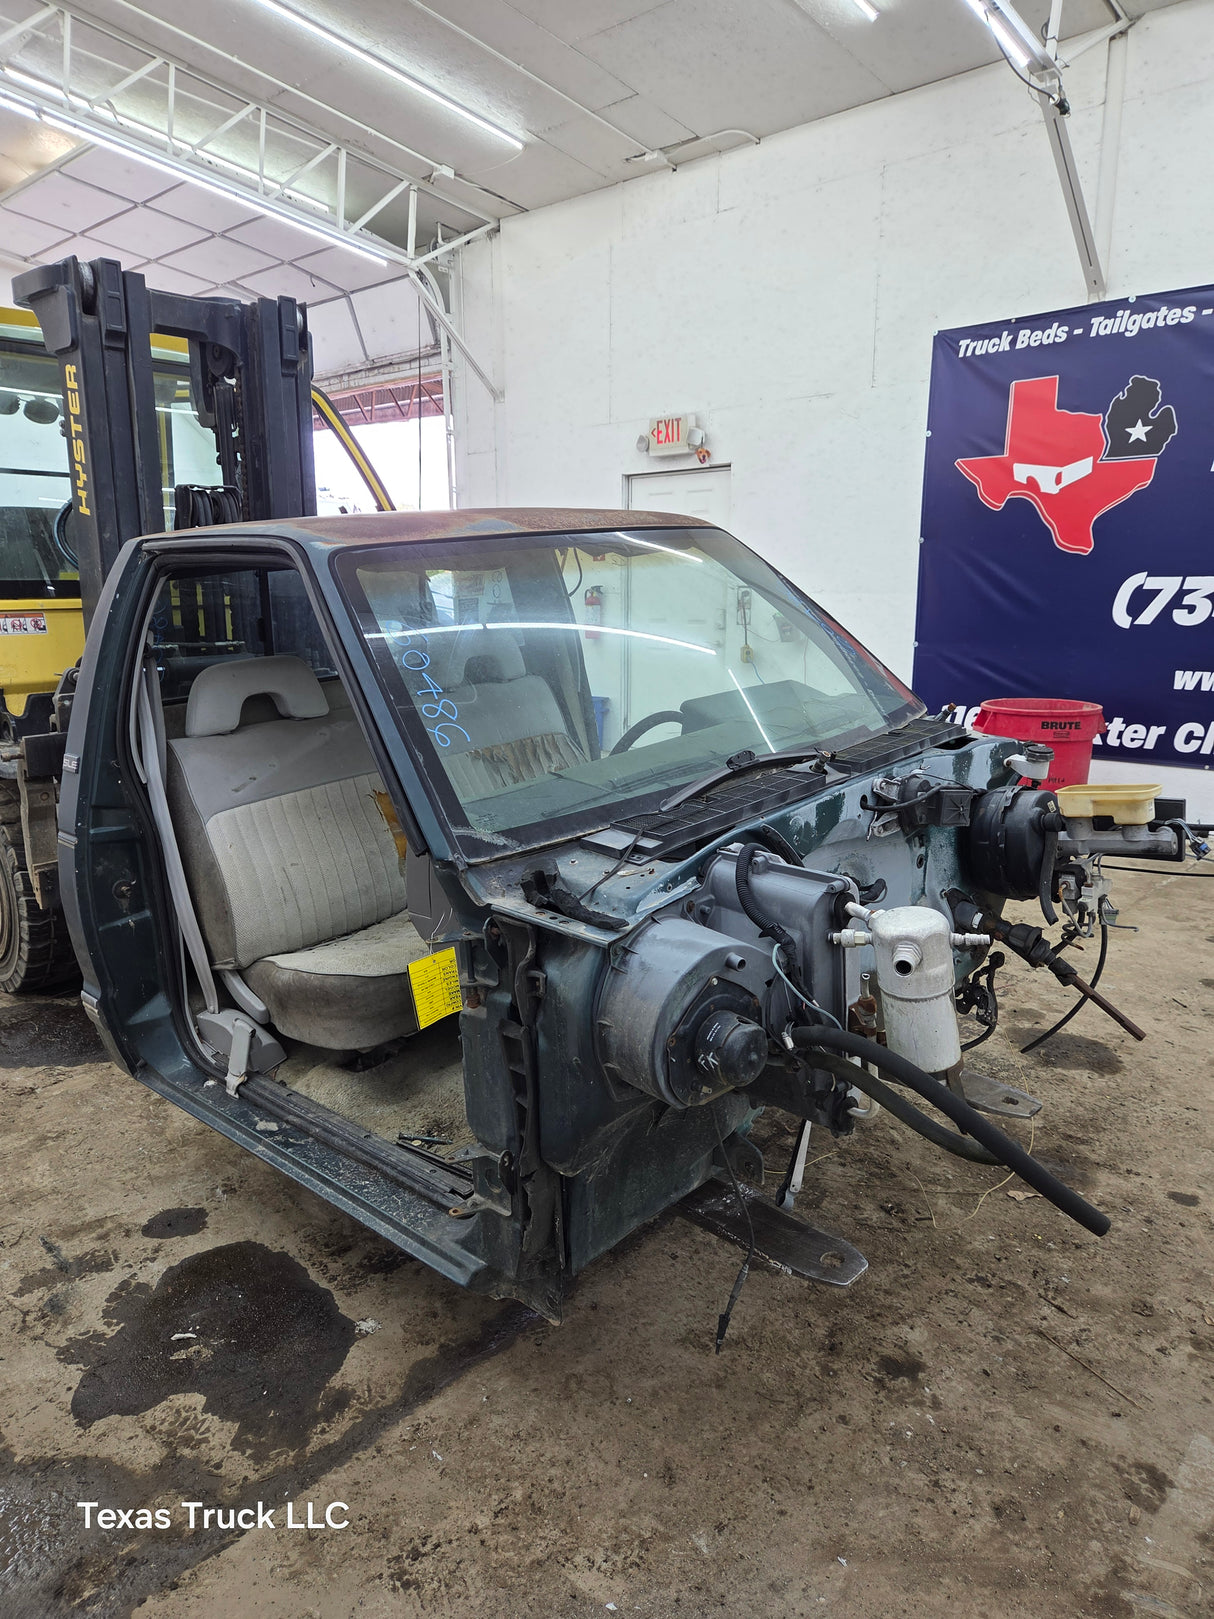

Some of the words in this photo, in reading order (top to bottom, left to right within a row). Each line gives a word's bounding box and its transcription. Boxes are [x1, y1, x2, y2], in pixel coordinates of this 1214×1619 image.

[958, 331, 1012, 358] Truck
[1015, 322, 1068, 349] Beds
[1089, 306, 1197, 337] Tailgates
[65, 364, 91, 516] HYSTER
[657, 418, 681, 444] EXIT
[1112, 571, 1214, 629] (73
[1041, 721, 1082, 730] BRUTE
[63, 758, 78, 770] SLE
